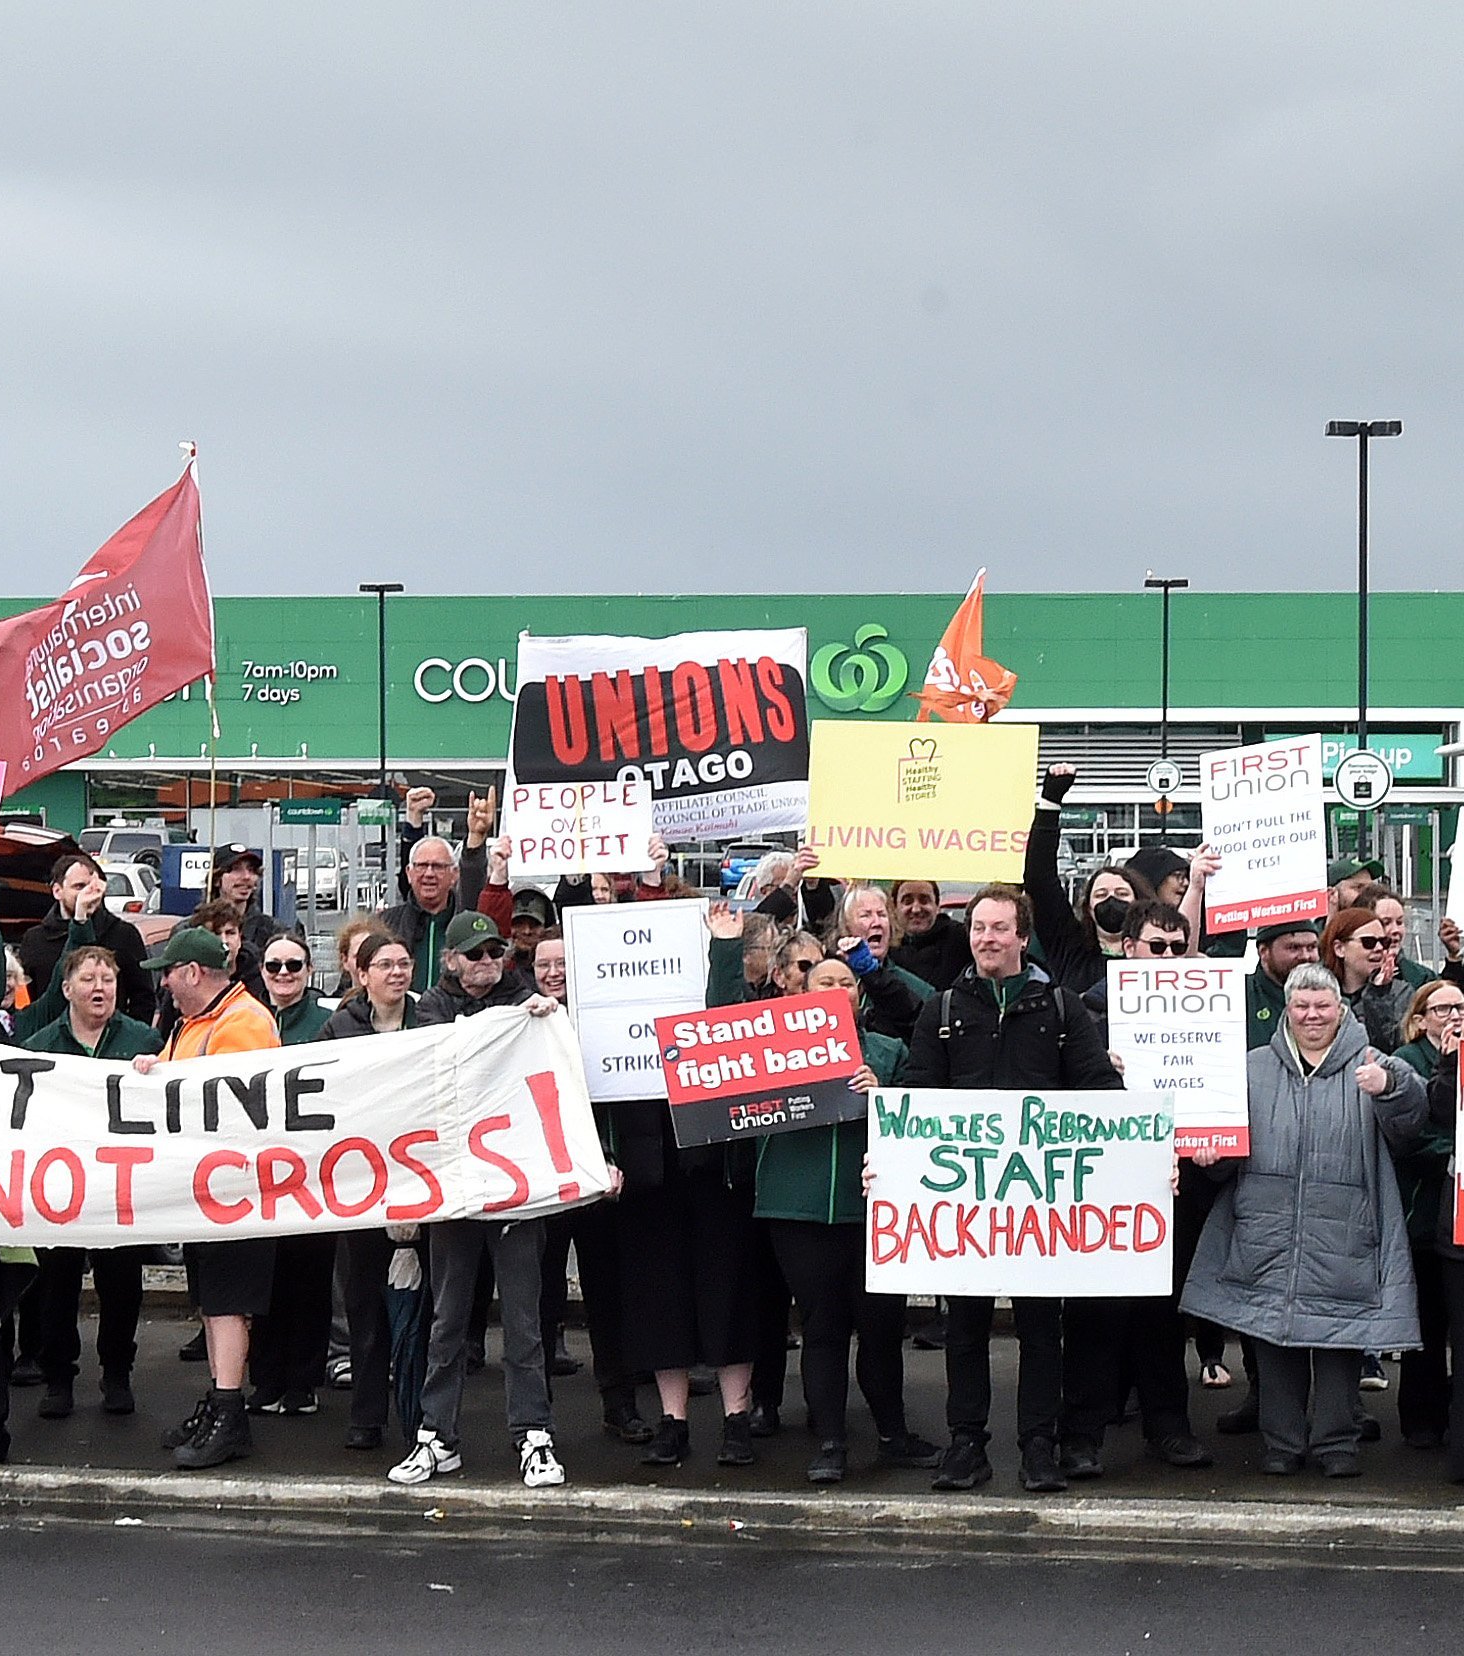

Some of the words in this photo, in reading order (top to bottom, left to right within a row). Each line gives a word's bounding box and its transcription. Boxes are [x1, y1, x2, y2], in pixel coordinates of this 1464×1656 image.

[242, 660, 338, 682] 7am-10pm
[413, 657, 518, 703] COU
[242, 684, 254, 701] 7
[257, 684, 300, 706] days
[545, 655, 796, 766] UNIONS
[616, 748, 754, 791] OTAGO
[512, 783, 637, 812] PEOPLE
[654, 796, 713, 813] AFFILIATE
[716, 787, 767, 803] COUNCIL
[551, 815, 602, 833] OVER
[654, 809, 710, 826] COUNCIL
[712, 807, 727, 818] OF
[728, 800, 768, 816] TRADE
[1256, 816, 1285, 830] PULL
[1290, 810, 1312, 824] THE
[520, 833, 630, 863] PROFIT
[810, 826, 907, 849] LIVING
[918, 828, 1030, 853] WAGES
[1211, 840, 1248, 855] WOOL
[1252, 834, 1286, 849] OVER
[1289, 829, 1317, 842] OUR
[185, 861, 210, 870] CLO
[1248, 855, 1281, 870] EYES!
[1294, 897, 1317, 912] First
[623, 929, 652, 945] ON
[596, 957, 682, 979] STRIKE!!!
[629, 1023, 656, 1040] ON
[673, 1009, 776, 1048] Stand
[784, 1006, 839, 1034] up,
[1134, 1033, 1156, 1044] WE
[1161, 1032, 1222, 1044] DESERVE
[676, 1052, 757, 1089] fight
[764, 1037, 852, 1074] back
[1163, 1055, 1194, 1066] FAIR
[1153, 1077, 1204, 1089] WAGES
[107, 1059, 340, 1135] LINE
[193, 1071, 581, 1224] CROSS!
[1174, 1136, 1209, 1147] orkers
[1212, 1134, 1238, 1148] First
[920, 1145, 1103, 1204] STAFF
[872, 1201, 1167, 1265] BACKHANDED
